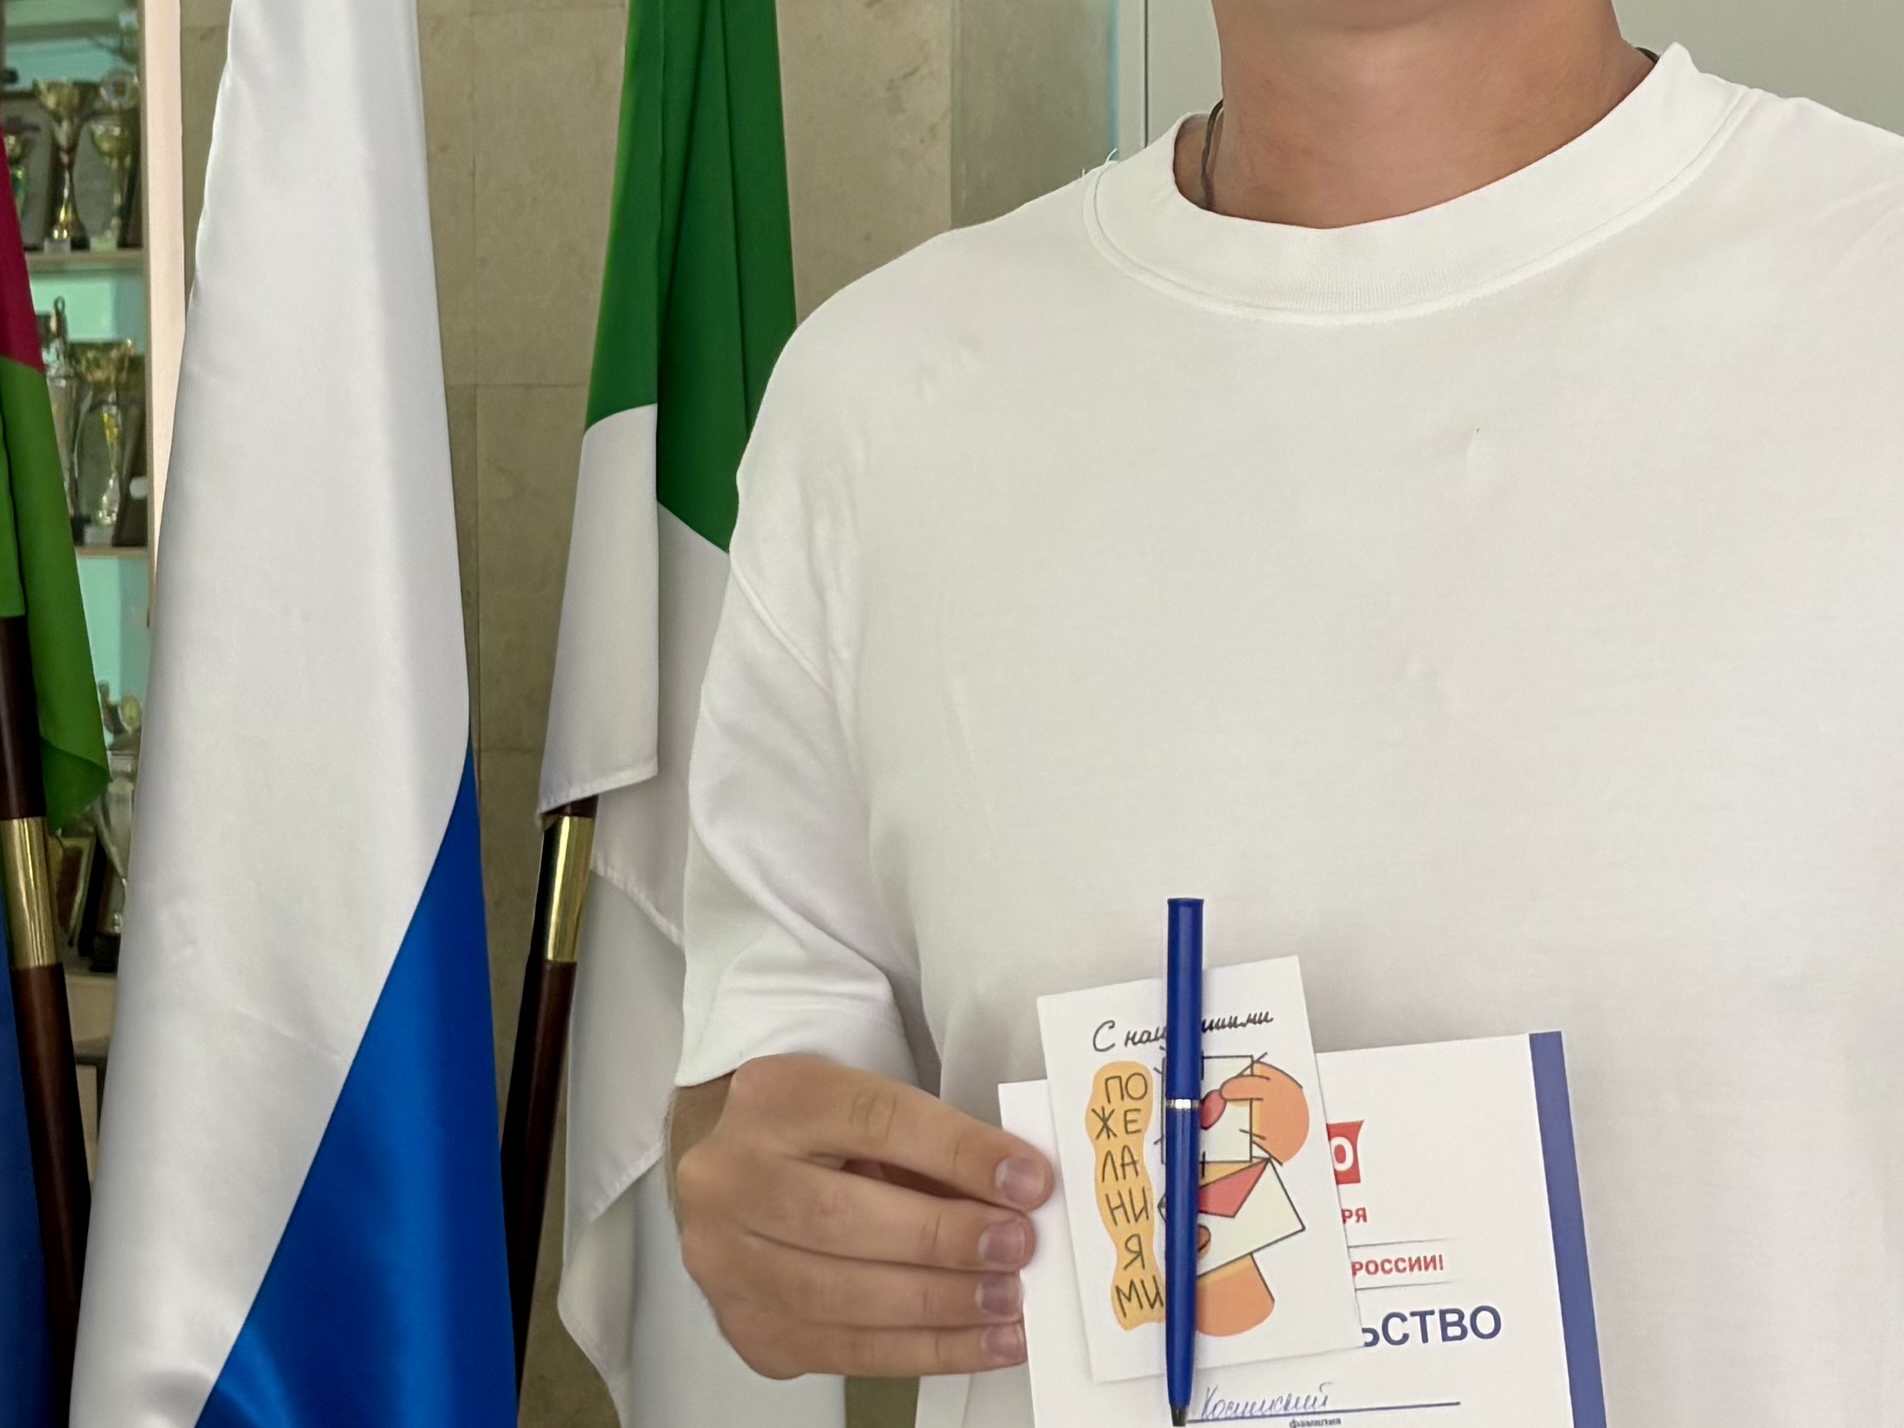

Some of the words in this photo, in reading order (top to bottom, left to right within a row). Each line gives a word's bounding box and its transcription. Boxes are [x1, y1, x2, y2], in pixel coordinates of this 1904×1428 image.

[1093, 1020, 1116, 1052] С
[1104, 1072, 1149, 1104] ПО
[1091, 1108, 1142, 1140] ЖЕ
[1101, 1145, 1140, 1183] ЛА
[1106, 1187, 1150, 1227] НИ
[1123, 1233, 1145, 1271] Я
[1351, 1254, 1444, 1276] РОССИИ!
[1114, 1274, 1164, 1318] МИ
